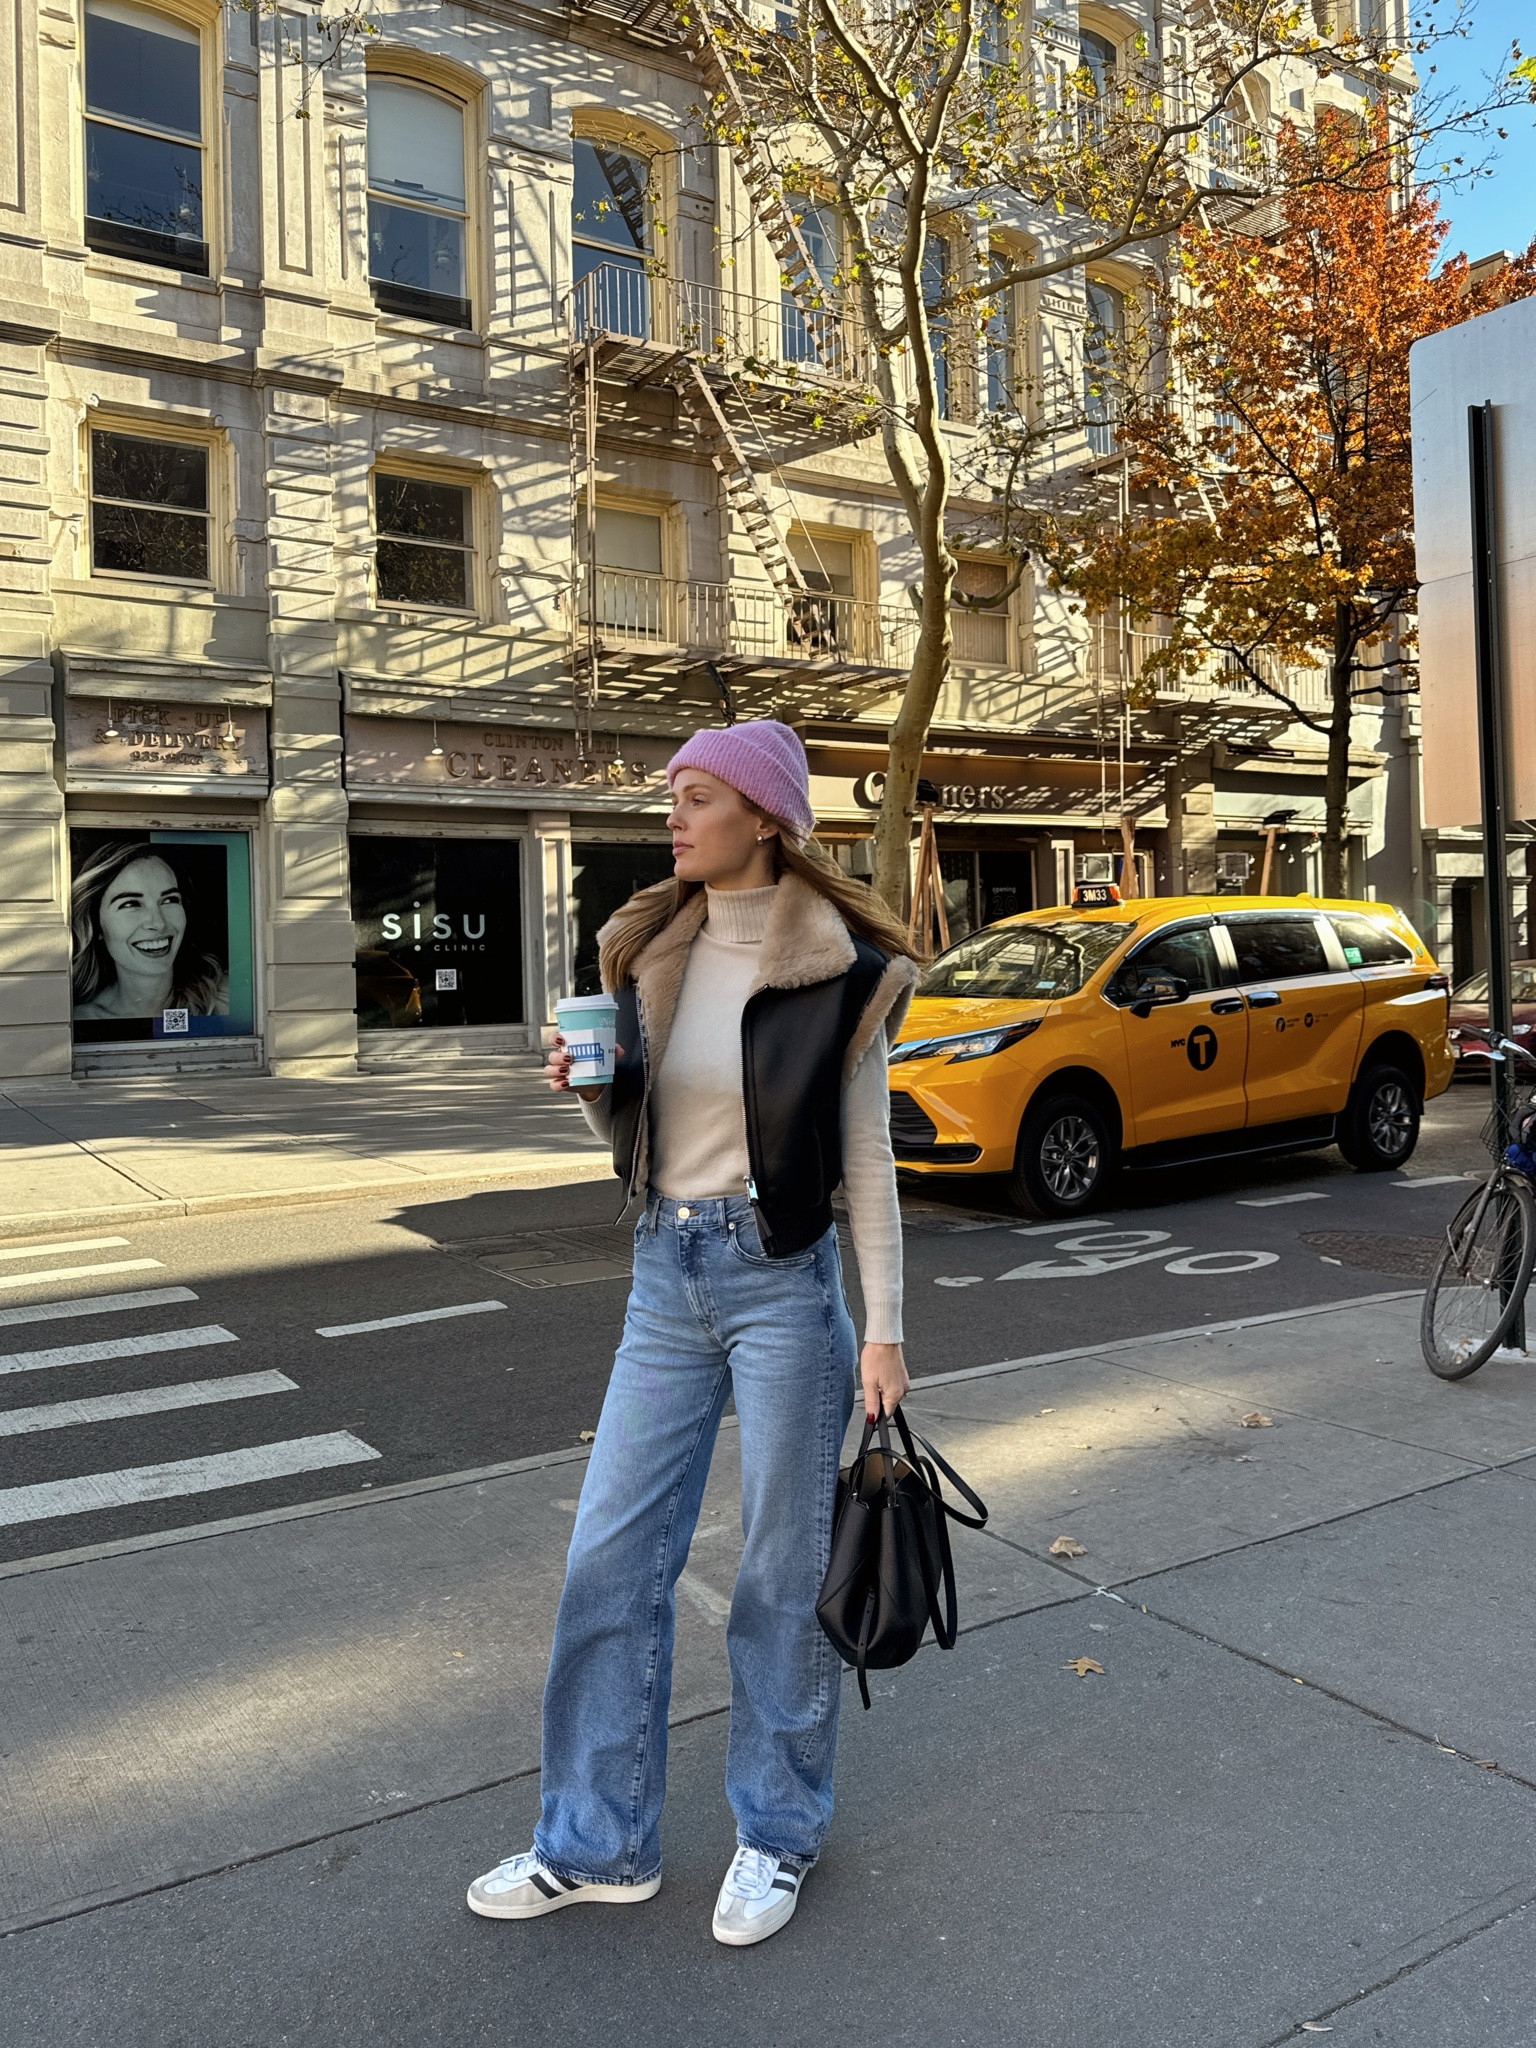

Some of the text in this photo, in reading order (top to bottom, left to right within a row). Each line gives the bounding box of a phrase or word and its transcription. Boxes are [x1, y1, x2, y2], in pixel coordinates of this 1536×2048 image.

[113, 706, 171, 726] PICK
[195, 712, 226, 729] UP
[482, 732, 564, 751] CLINTON
[445, 751, 648, 786] CLEANERS
[1082, 889, 1107, 902] 3M33
[433, 944, 486, 952] CLINIC
[1170, 1038, 1186, 1048] NYC
